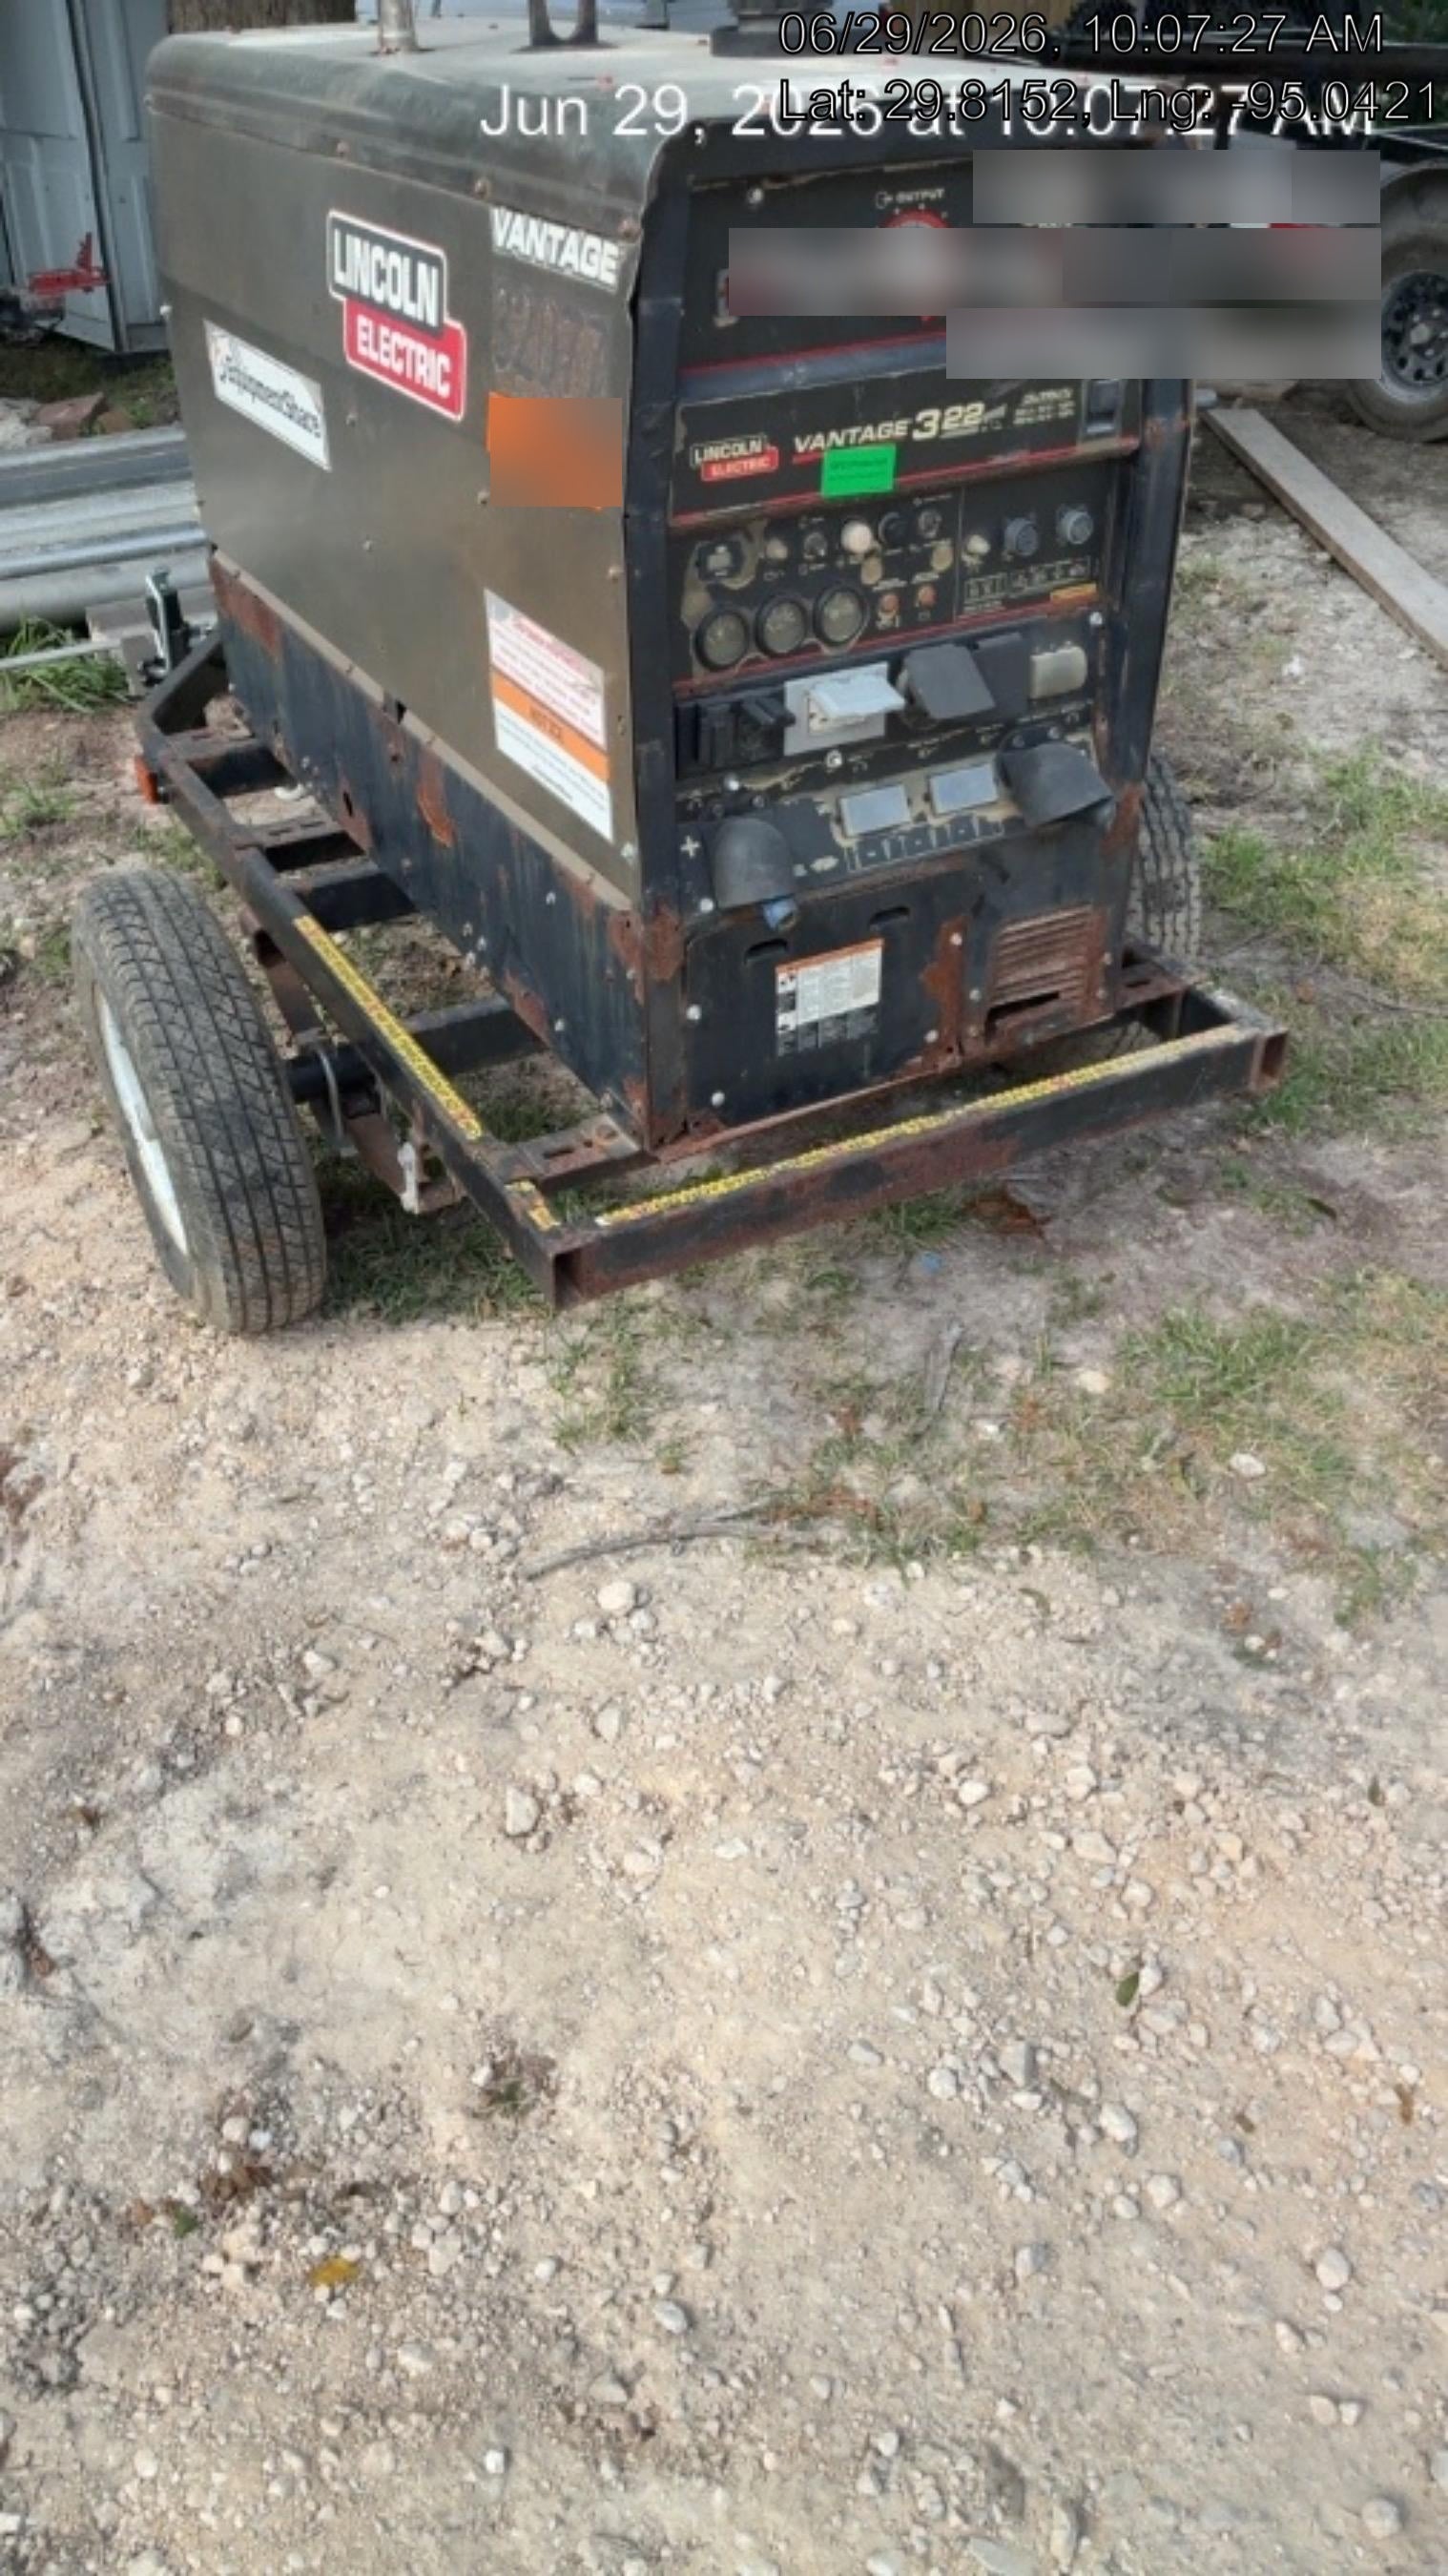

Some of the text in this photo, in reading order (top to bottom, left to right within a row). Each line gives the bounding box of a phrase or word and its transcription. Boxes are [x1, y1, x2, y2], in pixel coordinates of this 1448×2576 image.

[334, 228, 439, 328] LINCOLN
[490, 206, 620, 287] VANTAGE
[356, 314, 451, 399] ELECTRIC
[694, 438, 764, 464] LINCOLN
[794, 418, 912, 453] VANTAGE
[912, 400, 985, 441] 322
